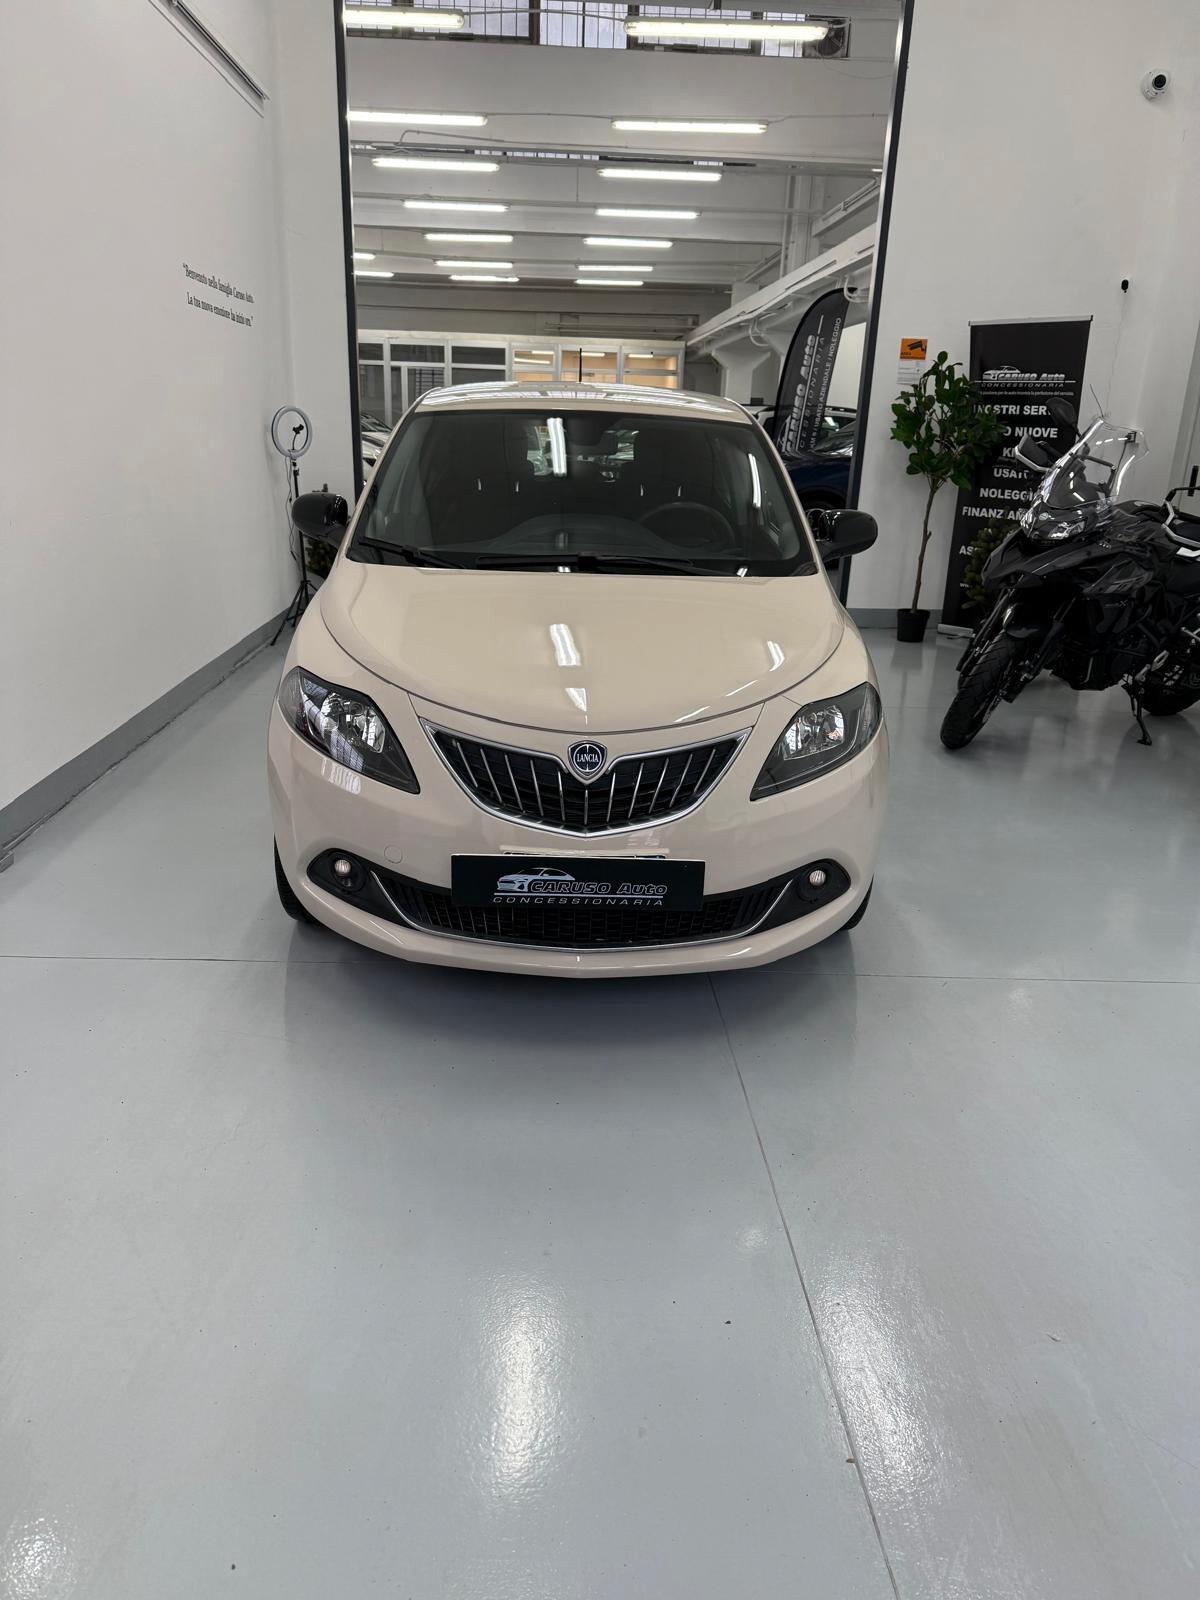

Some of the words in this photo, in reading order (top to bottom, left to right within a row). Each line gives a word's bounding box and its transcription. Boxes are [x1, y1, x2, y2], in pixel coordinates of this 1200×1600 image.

[818, 361, 831, 403] AZIENDALE
[829, 317, 842, 356] NOLEGGIO
[997, 373, 1038, 381] CARUSO
[799, 337, 825, 449] CESSIONARIA
[1015, 426, 1059, 438] NUOVE
[979, 487, 1035, 501] NOLEGGI
[576, 753, 599, 763] LANCIA
[530, 880, 612, 894] CARUSO
[616, 882, 668, 895] Auto
[493, 896, 663, 907] CONCESSIONARIA
